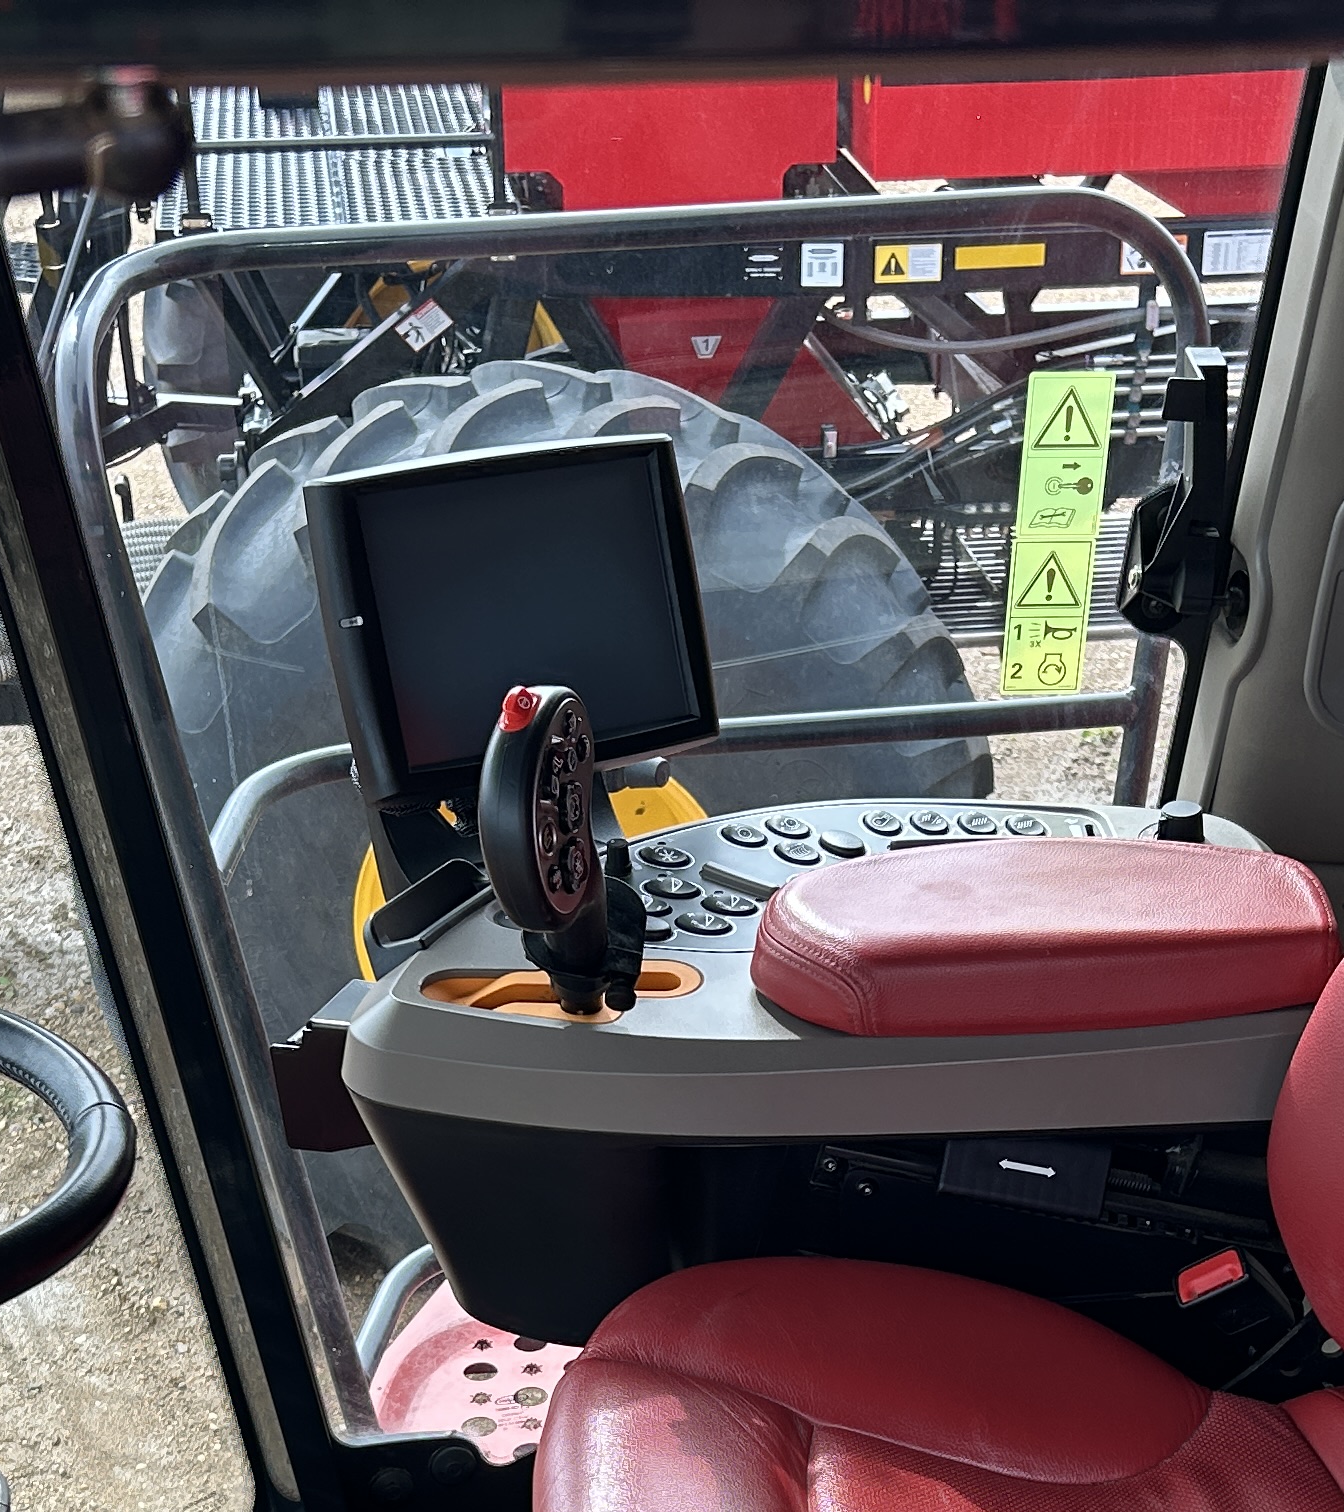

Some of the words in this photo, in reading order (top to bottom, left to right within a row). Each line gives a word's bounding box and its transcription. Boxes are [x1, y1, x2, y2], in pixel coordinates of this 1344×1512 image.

[702, 338, 709, 351] 1
[1013, 624, 1022, 640] 1
[1029, 640, 1042, 648] 3X
[1010, 662, 1023, 679] 2
